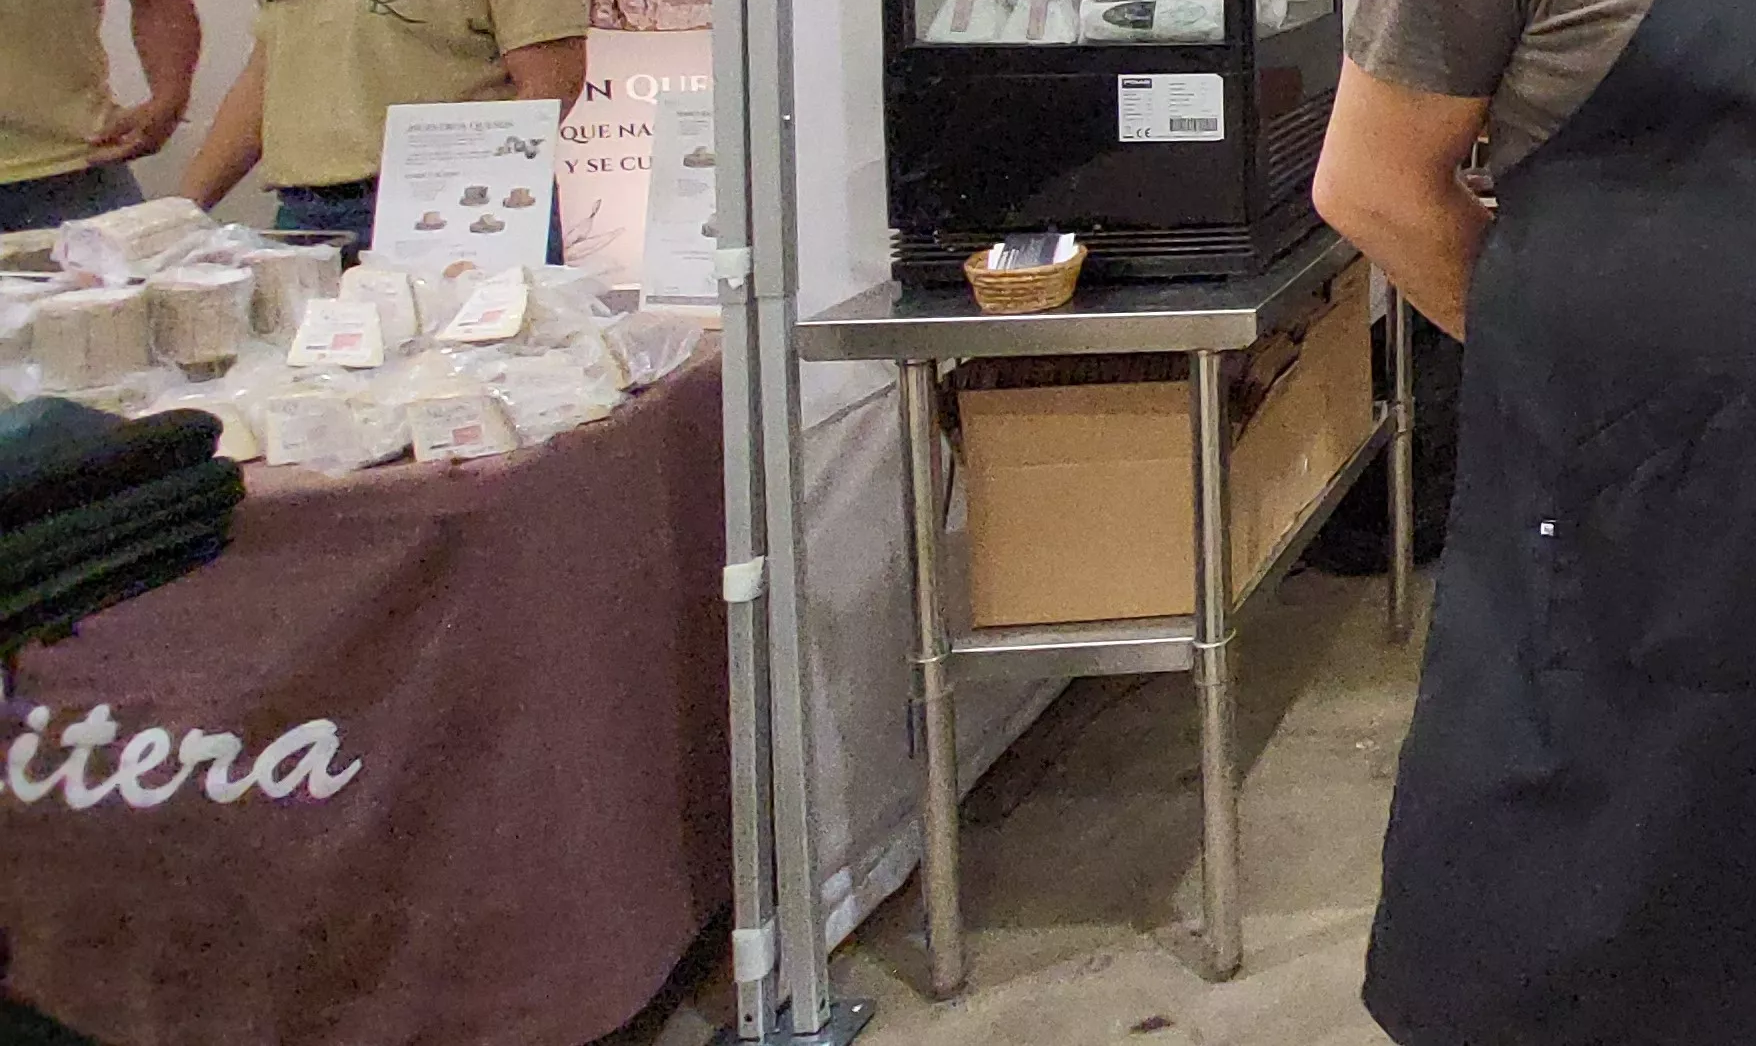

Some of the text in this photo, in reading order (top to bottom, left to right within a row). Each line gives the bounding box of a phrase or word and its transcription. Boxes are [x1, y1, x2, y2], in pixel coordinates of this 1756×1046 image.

[560, 123, 611, 144] QUE
[565, 159, 579, 174] Y
[587, 157, 614, 173] SE
[0, 704, 363, 810] itera
